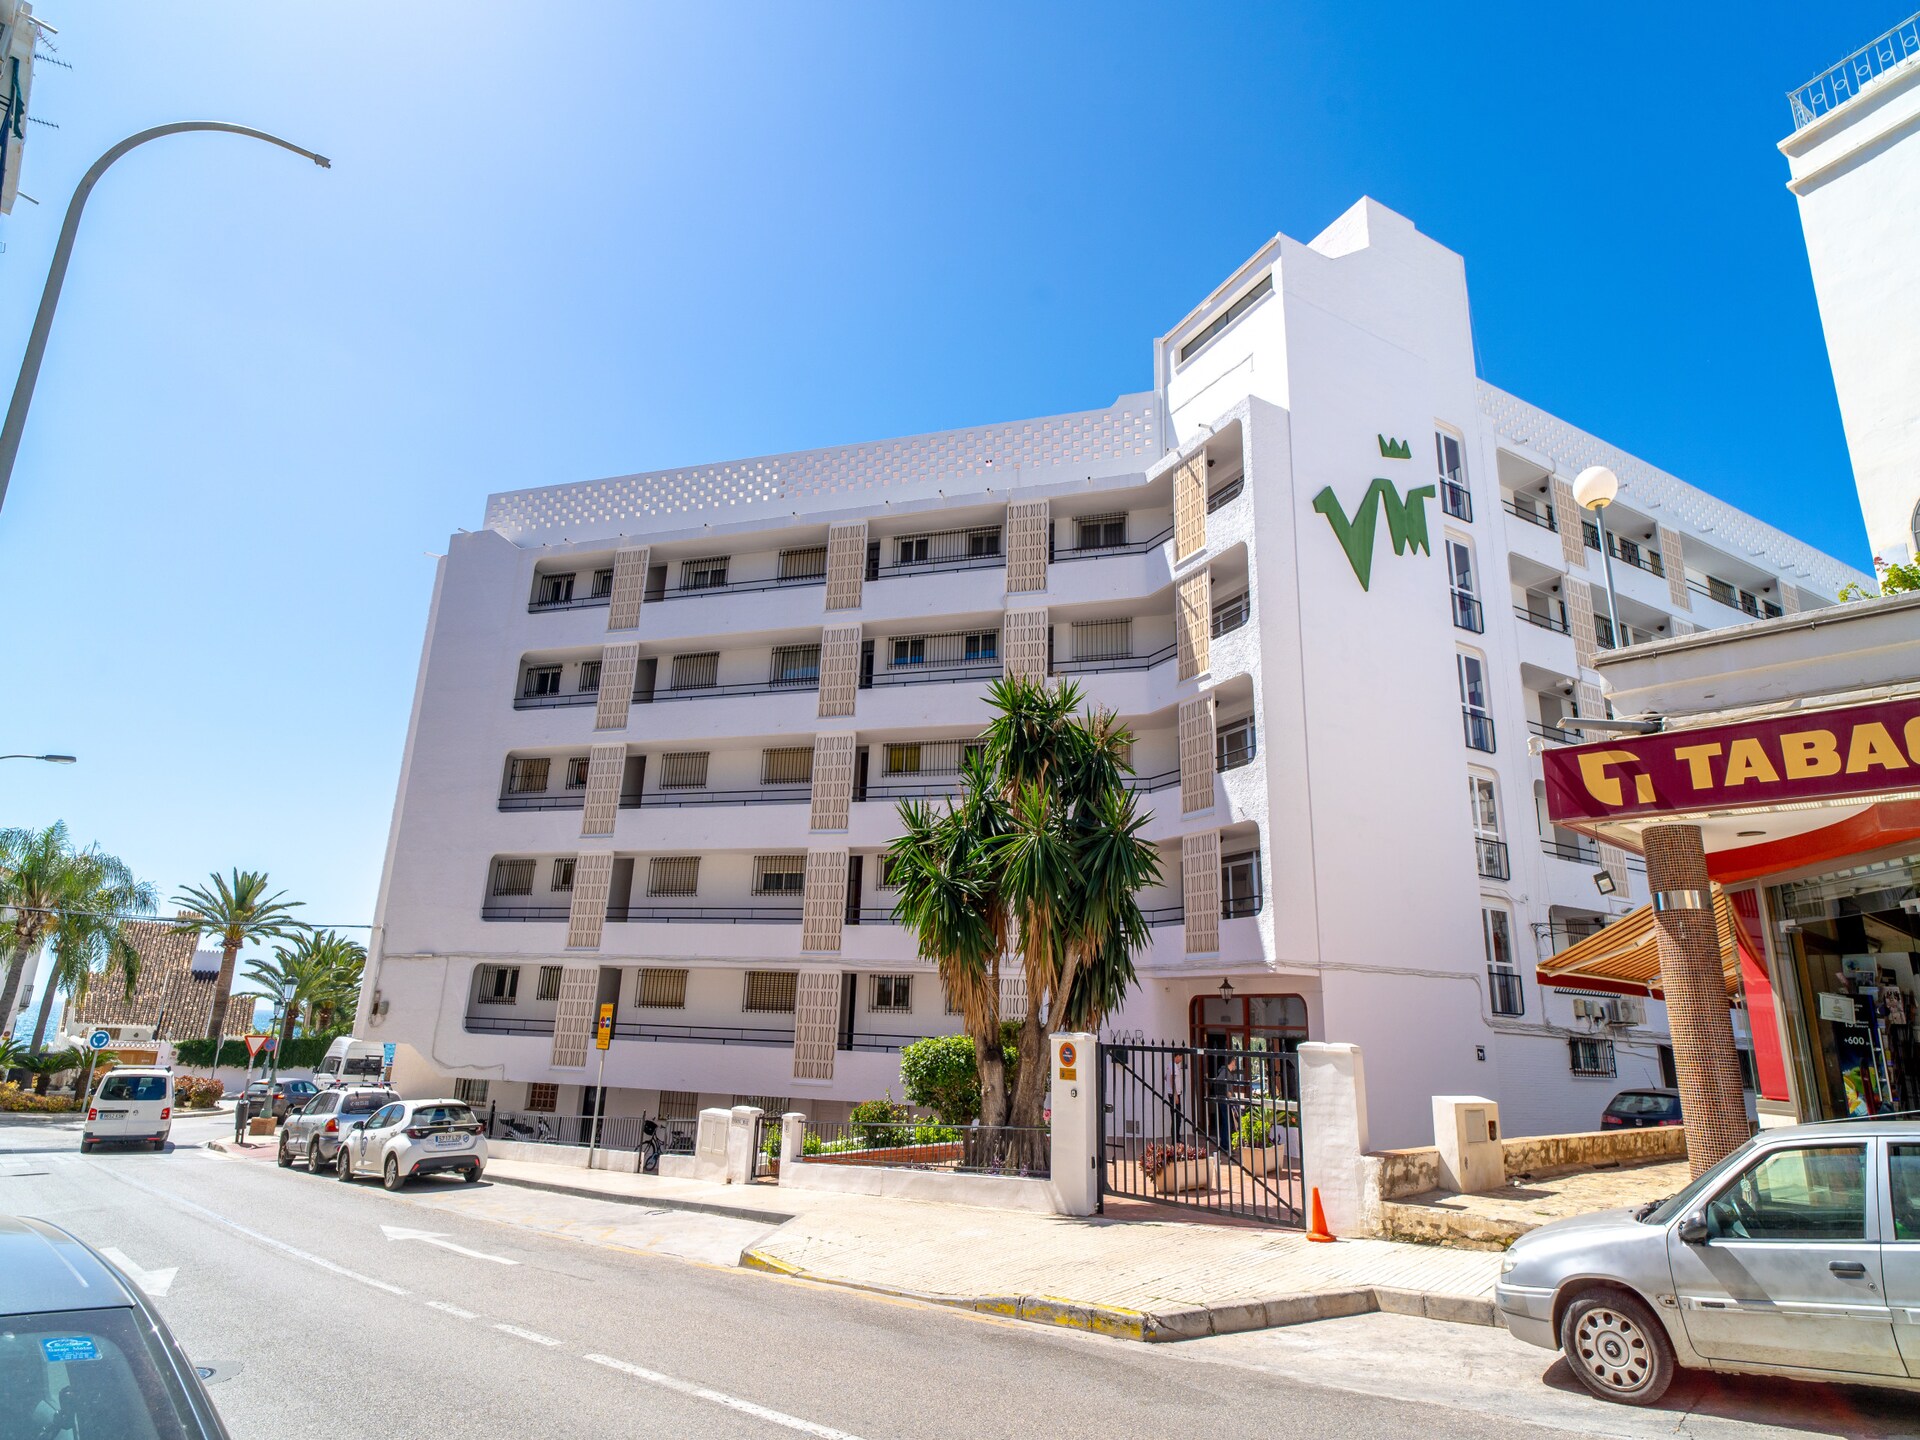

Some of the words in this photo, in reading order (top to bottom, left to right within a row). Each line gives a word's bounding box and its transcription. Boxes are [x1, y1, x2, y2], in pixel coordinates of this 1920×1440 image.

[1674, 716, 1920, 790] TABA
[1110, 1029, 1144, 1045] MAR
[1844, 1036, 1865, 1045] +600
